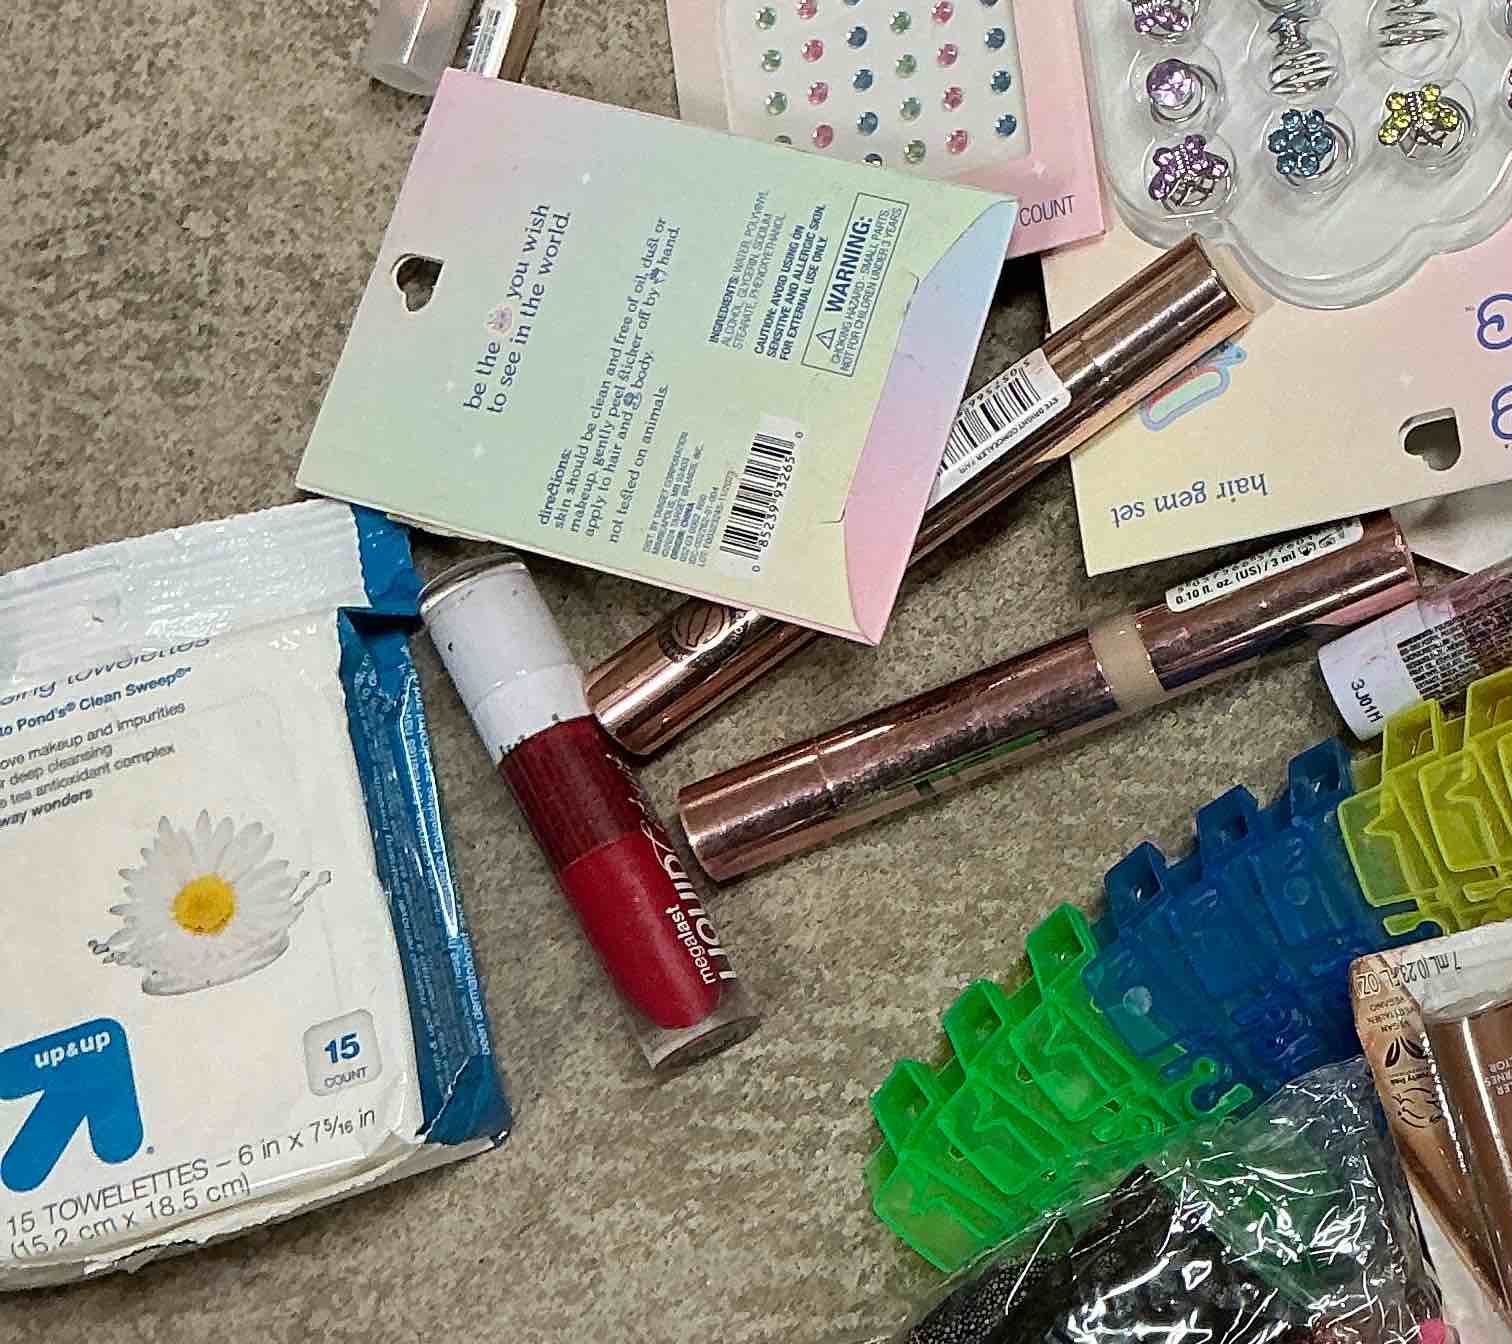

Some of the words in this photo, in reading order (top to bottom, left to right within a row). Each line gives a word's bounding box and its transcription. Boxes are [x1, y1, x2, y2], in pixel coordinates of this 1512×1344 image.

[1017, 194, 1076, 226] COUNT
[537, 211, 570, 275] world.
[826, 216, 873, 315] WARNING:
[462, 382, 486, 409] be
[475, 341, 500, 375] the
[505, 261, 530, 300] you
[521, 204, 550, 252] wish
[520, 283, 544, 317] the
[641, 287, 660, 306] by
[510, 325, 531, 344] in
[498, 348, 522, 386] see
[487, 392, 507, 413] to
[563, 443, 591, 496] should
[580, 420, 598, 442] be
[605, 346, 621, 377] and
[613, 314, 634, 345] free
[601, 443, 622, 473] hair
[614, 410, 633, 440] and
[607, 517, 624, 544] not
[633, 446, 648, 467] on
[750, 563, 761, 573] 0
[757, 503, 780, 547] 85239
[773, 454, 796, 499] 93265
[793, 429, 804, 439] 0
[1153, 480, 1207, 512] gem
[1215, 472, 1268, 503] hair
[1110, 500, 1145, 528] set
[1174, 589, 1200, 604] 0.10
[1234, 563, 1263, 582] (US)
[1270, 557, 1279, 567] 3
[77, 687, 122, 711] Clean
[26, 733, 84, 761] makeup
[84, 722, 114, 741] and
[116, 699, 187, 734] impurities
[8, 765, 45, 787] deep
[45, 742, 114, 774] cleansing
[111, 741, 176, 772] complex
[28, 786, 94, 818] wonders
[665, 906, 716, 985] megalast
[1429, 953, 1449, 974] mL
[1452, 951, 1461, 969] 7
[34, 1031, 112, 1069] up&up
[321, 1032, 363, 1065] 15
[322, 1066, 370, 1088] COUNT
[6, 1210, 35, 1236] 15
[43, 1157, 209, 1220] TOWELETTES
[235, 1144, 255, 1166] 6
[261, 1138, 280, 1157] in
[287, 1131, 303, 1151] x
[357, 1109, 375, 1126] in
[78, 1217, 116, 1241] cm
[122, 1210, 138, 1229] x
[144, 1188, 198, 1219] 18.5
[205, 1171, 250, 1203] cm)
